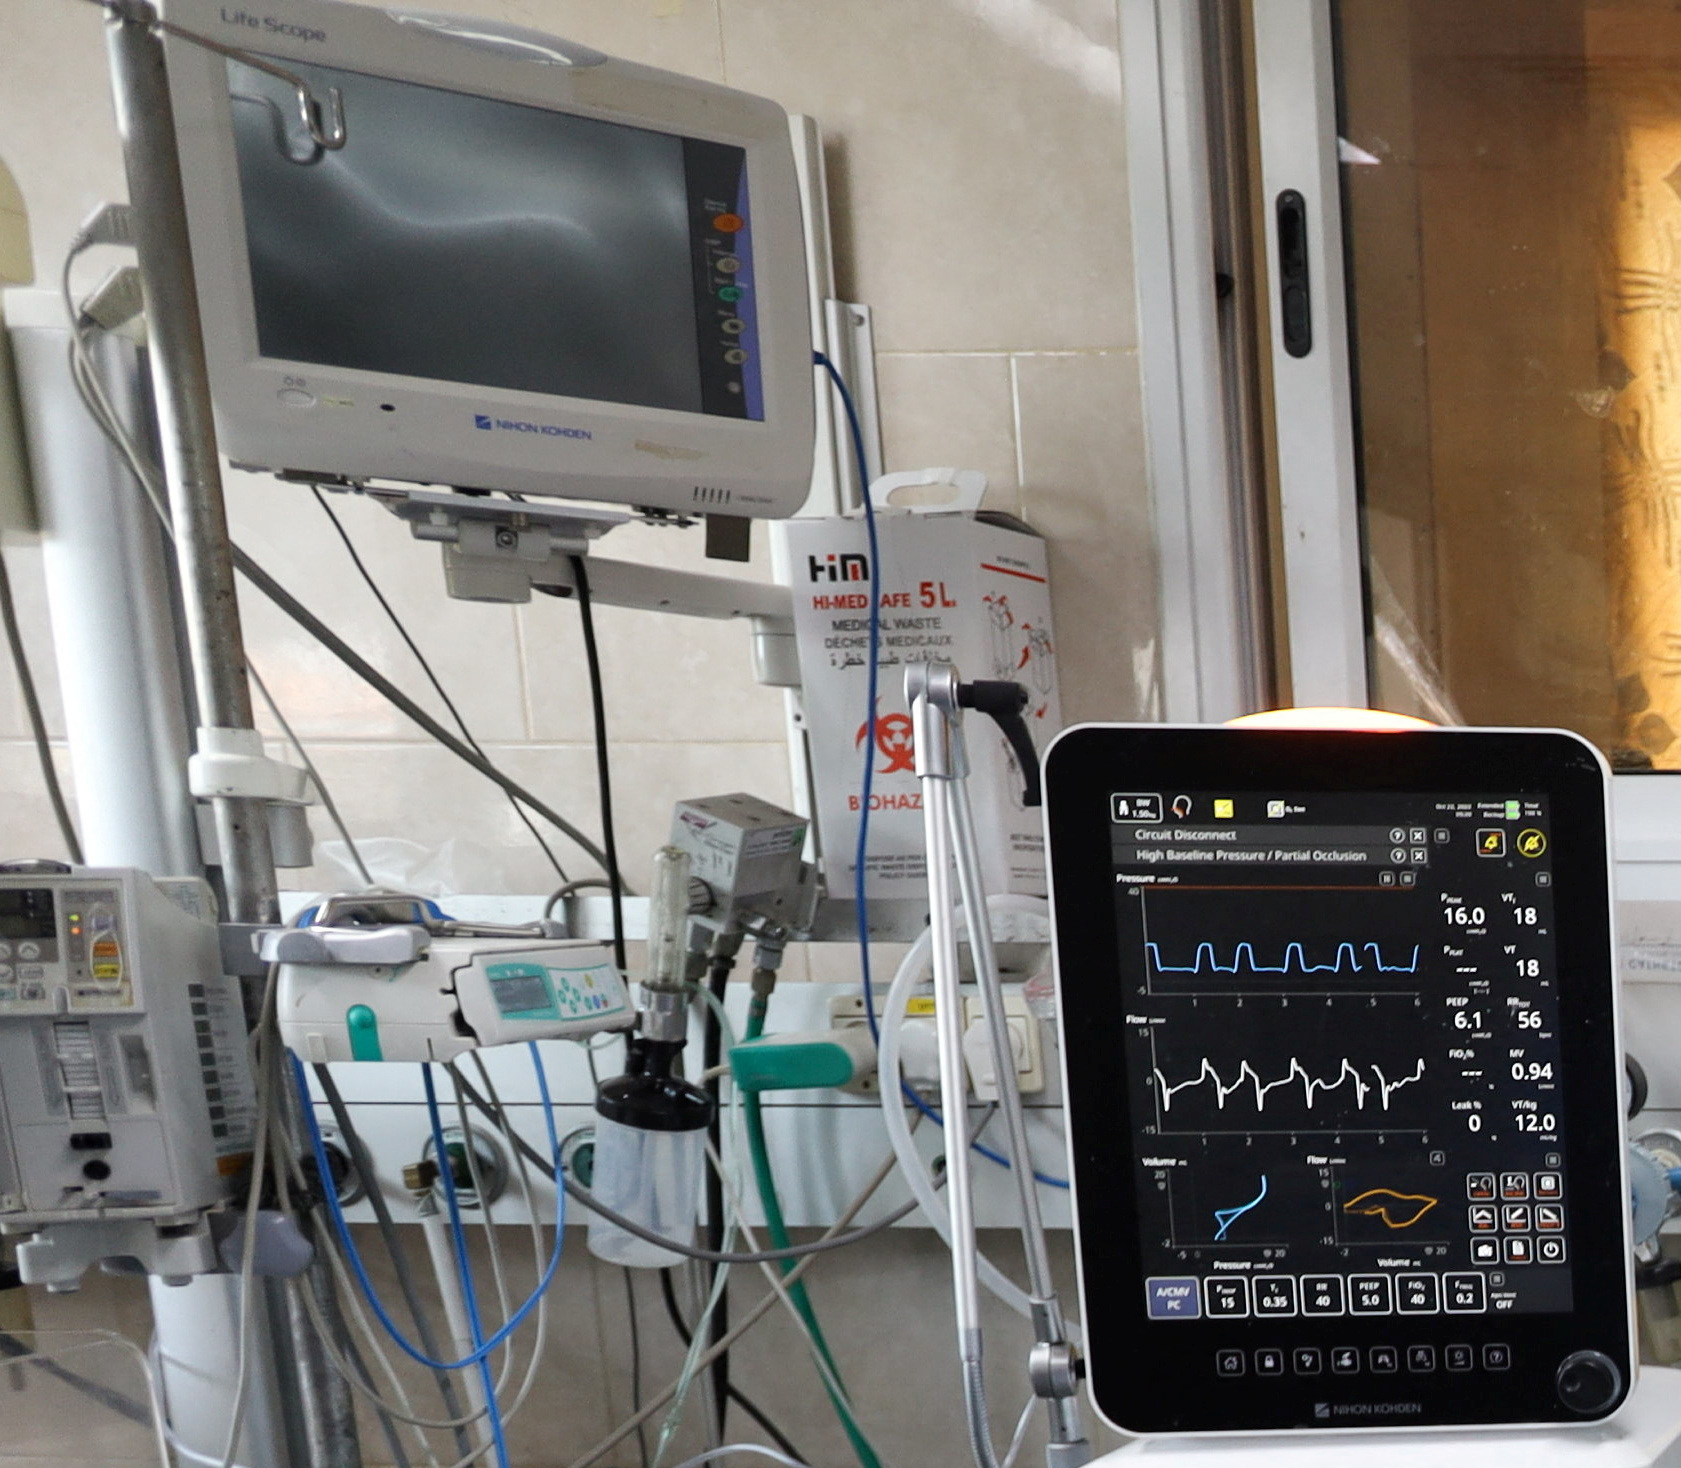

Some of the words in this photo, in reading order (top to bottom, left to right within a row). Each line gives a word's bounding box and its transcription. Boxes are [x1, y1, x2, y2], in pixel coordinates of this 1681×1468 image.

[221, 9, 259, 27] Life
[264, 16, 325, 42] Scope
[497, 420, 538, 433] NIHON
[541, 425, 592, 440] KOHDEN
[874, 593, 911, 608] AFE
[893, 618, 941, 629] WASTE
[1135, 829, 1172, 841] Circuit
[1175, 829, 1236, 841] Disconnect
[1136, 850, 1164, 862] High
[1167, 850, 1214, 860] Baseline
[1216, 851, 1264, 861] Pressure
[1275, 851, 1310, 861] Partial
[1313, 851, 1367, 862] Occlusion
[1116, 874, 1155, 883] Pressure
[1444, 907, 1485, 924] 16.0
[1514, 908, 1537, 924] 18
[1504, 945, 1516, 954] VT
[1516, 960, 1539, 977] 18
[1446, 997, 1468, 1006] PEEP
[1126, 1015, 1147, 1025] Flow
[1455, 1011, 1481, 1029] 6.1
[1518, 1011, 1542, 1029] 56
[1510, 1049, 1524, 1058] MV
[1512, 1063, 1553, 1080] 0.94
[1452, 1101, 1472, 1110] Leak
[1468, 1114, 1481, 1132] 0
[1515, 1114, 1556, 1132] 12.0
[1142, 1157, 1176, 1168] Volume
[1307, 1155, 1327, 1165] Flow
[1213, 1261, 1251, 1270] Pressure
[1377, 1258, 1410, 1268] Volume
[1221, 1297, 1235, 1308] 15
[1263, 1296, 1287, 1308] 0.35
[1316, 1296, 1330, 1307] 40
[1362, 1294, 1379, 1305] 5.0
[1410, 1293, 1425, 1304] 40
[1456, 1293, 1473, 1304] 0.2
[1496, 1301, 1512, 1309] OFF
[1333, 1404, 1370, 1415] NIHON
[1374, 1403, 1421, 1415] KOHDEN
